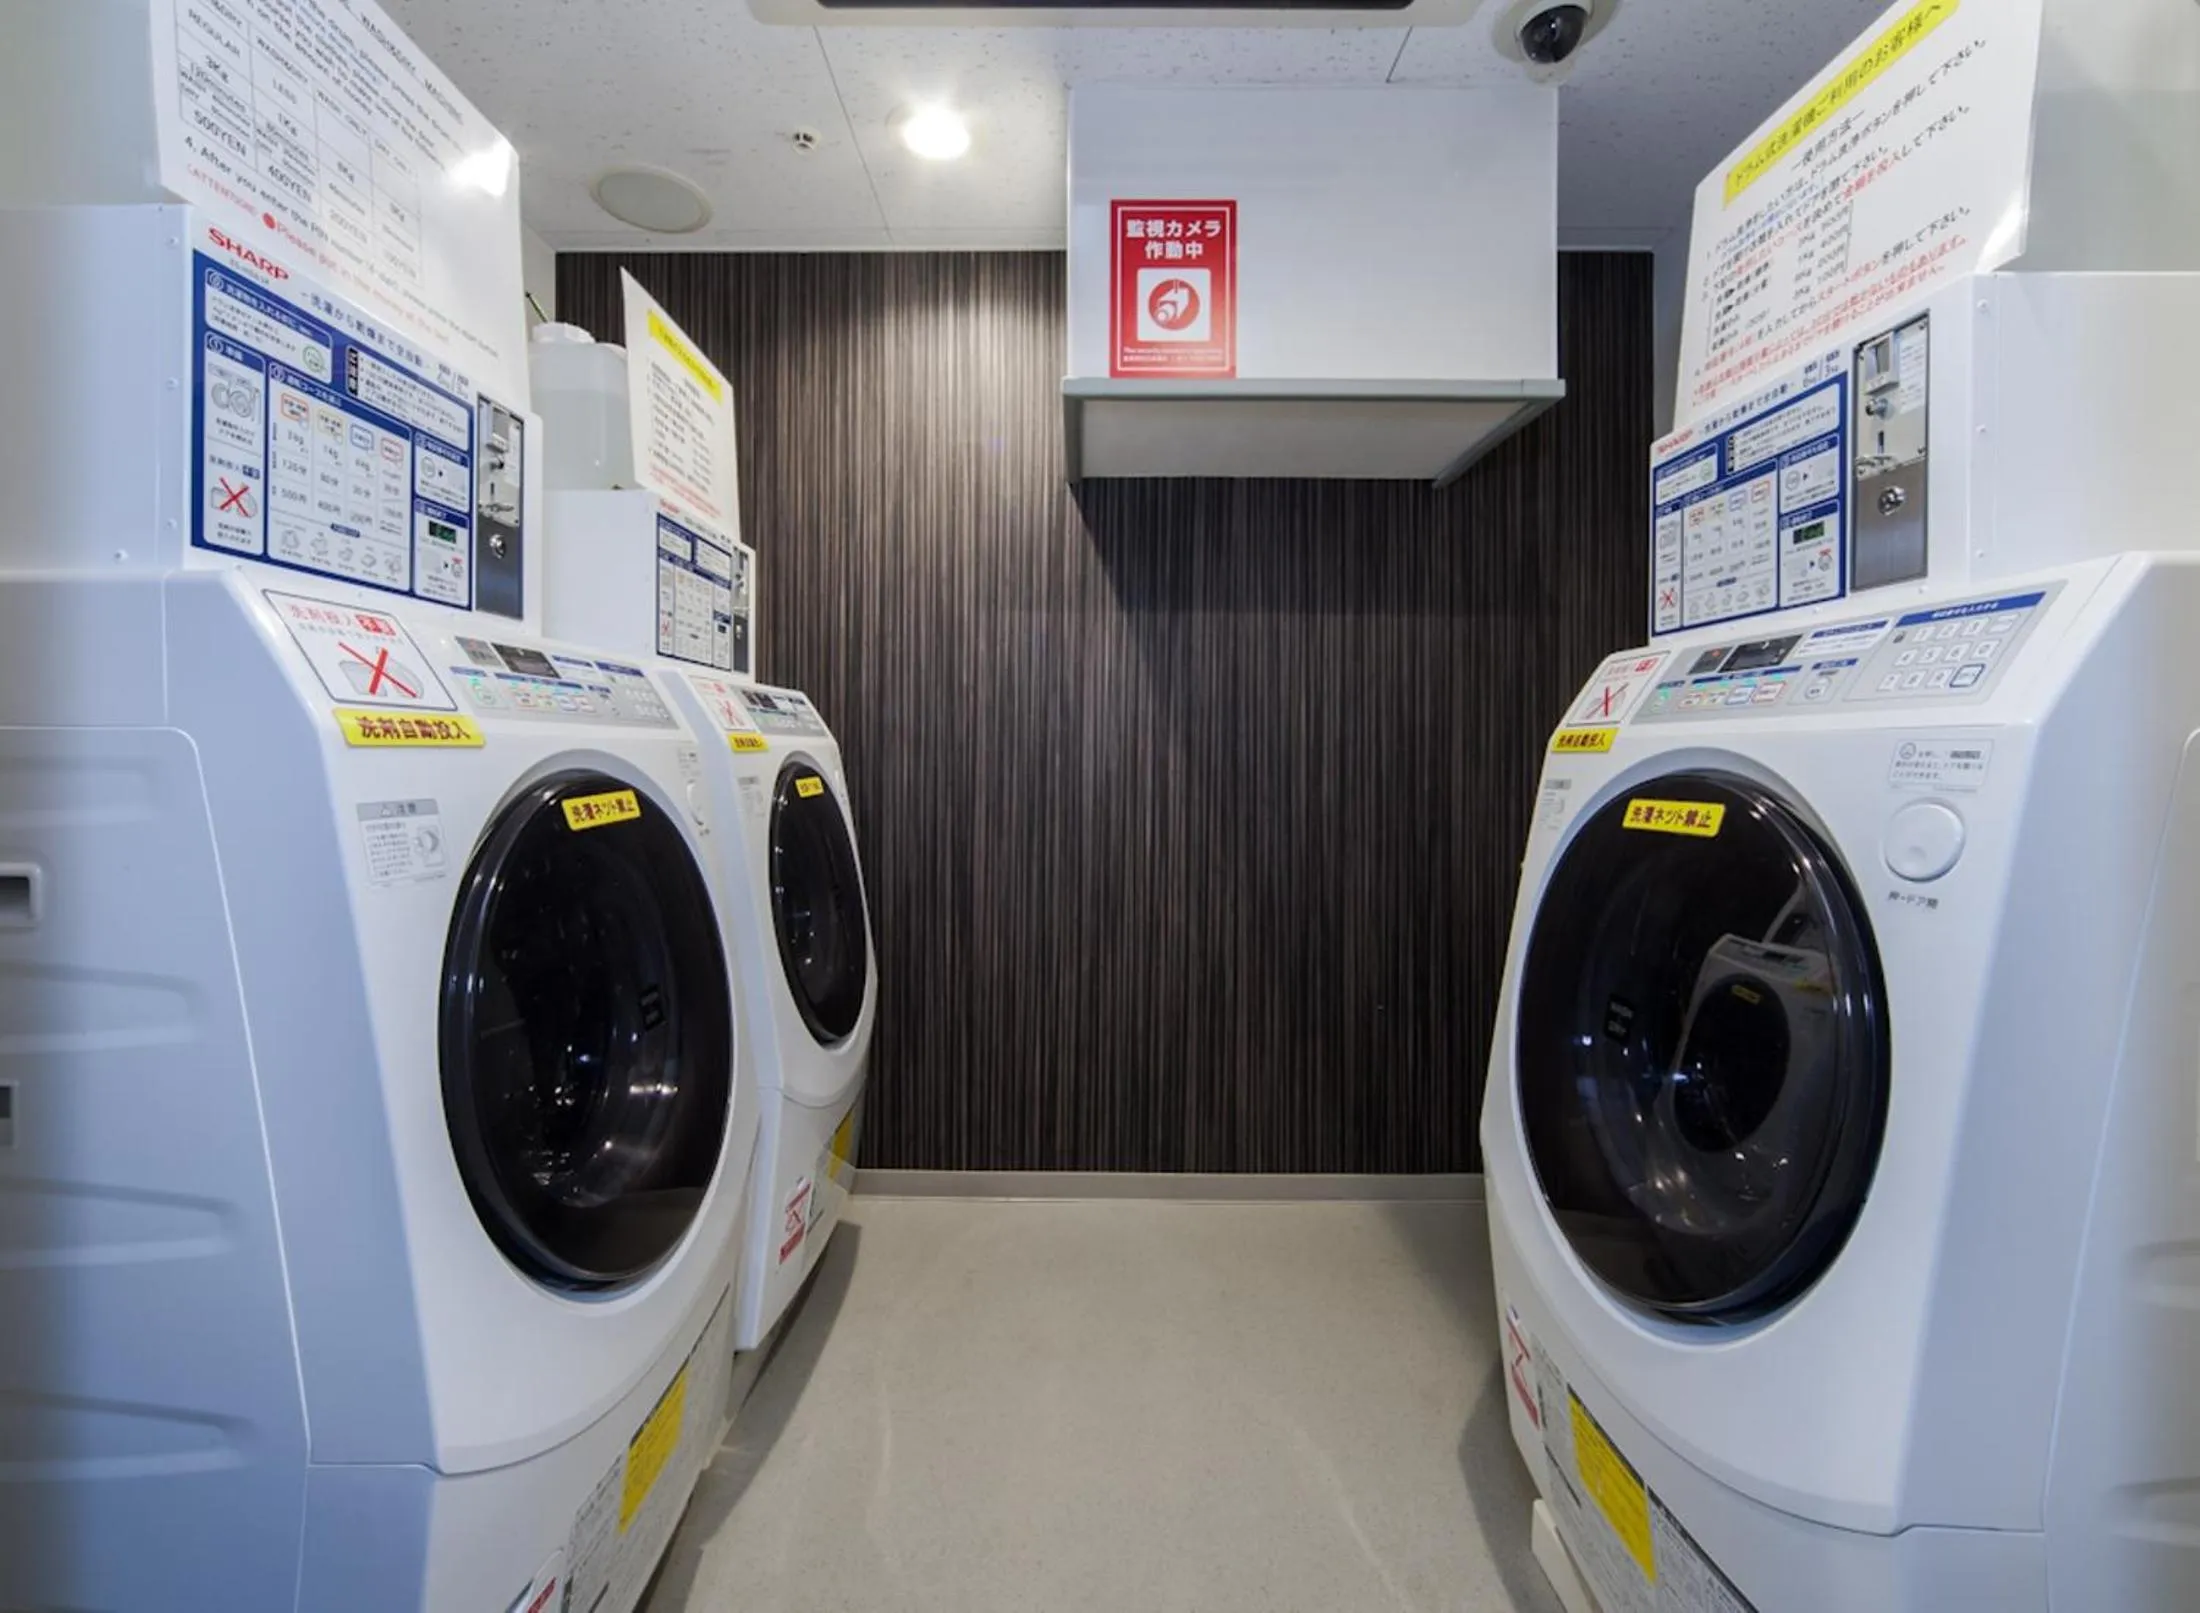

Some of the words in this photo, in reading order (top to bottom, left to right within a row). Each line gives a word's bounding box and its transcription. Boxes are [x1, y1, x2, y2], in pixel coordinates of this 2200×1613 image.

[1126, 218, 1222, 239] 監視カメラ
[208, 227, 289, 280] SHARP
[1144, 240, 1204, 260] 作動中
[356, 716, 471, 741] 洗剤自動投入
[1629, 805, 1713, 829] 洗濯ネット禁止
